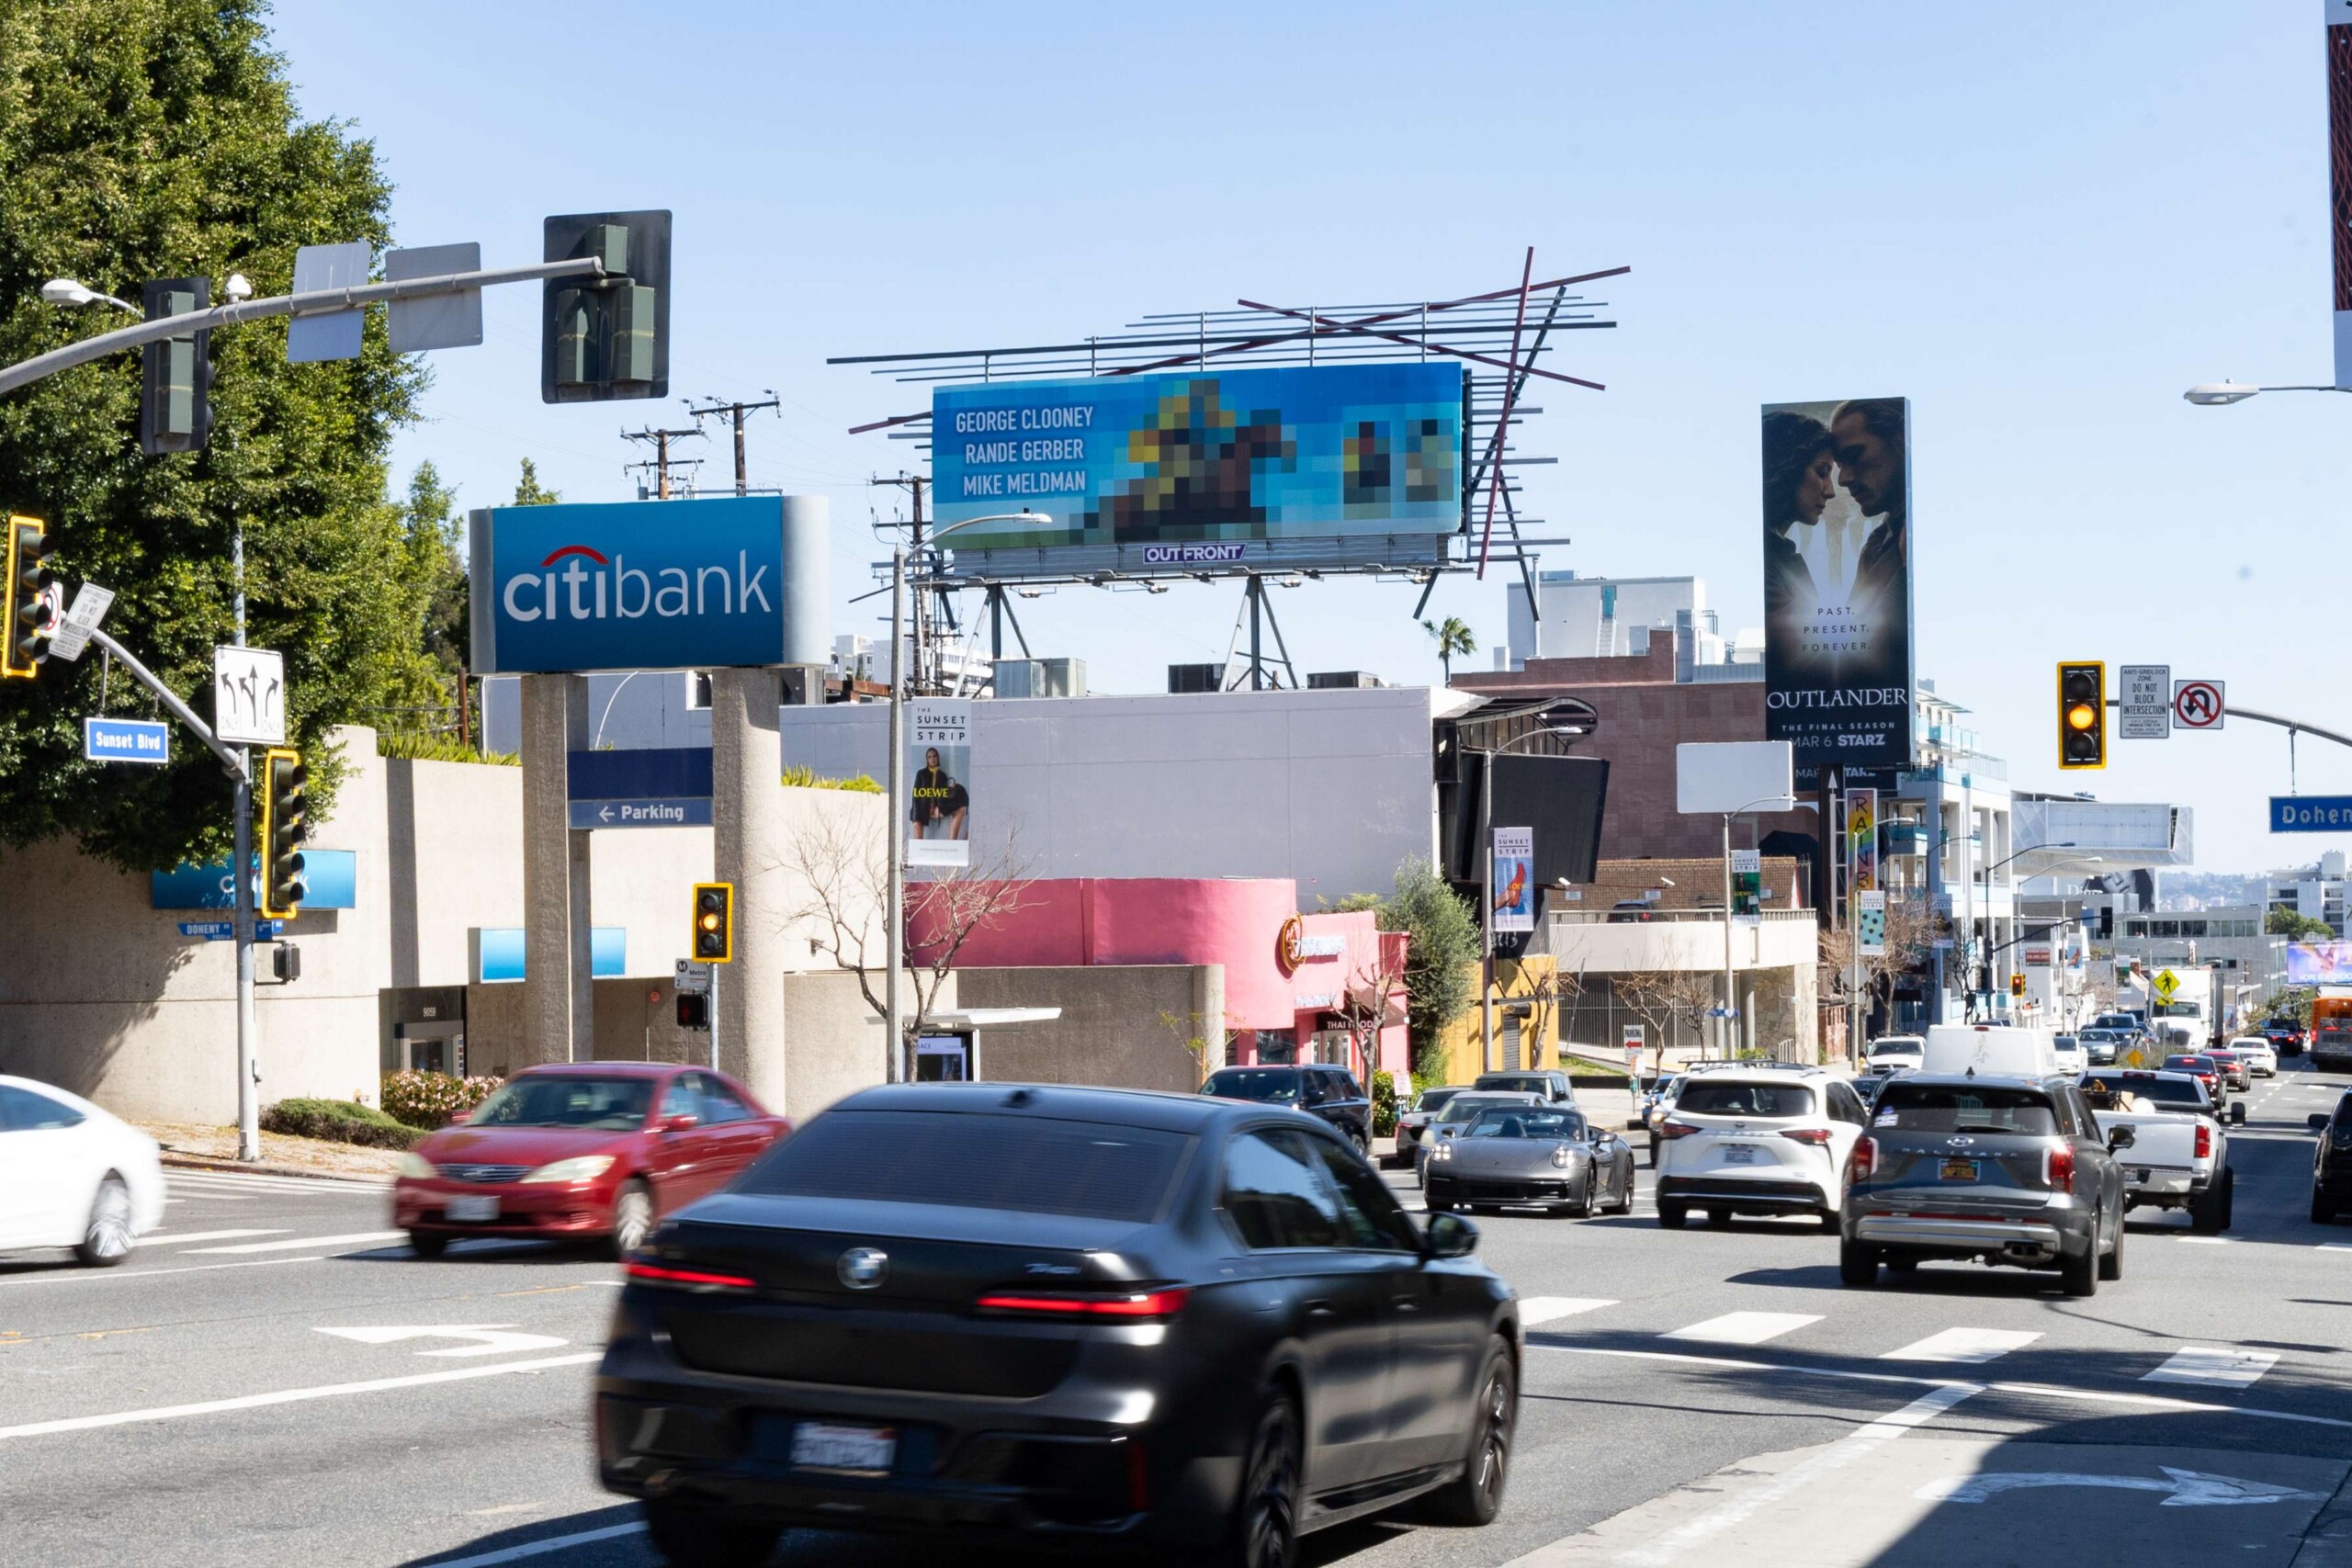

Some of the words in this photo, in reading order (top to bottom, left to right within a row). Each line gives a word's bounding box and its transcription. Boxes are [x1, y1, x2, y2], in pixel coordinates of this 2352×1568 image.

[956, 410, 1017, 433] GEORGE
[1022, 406, 1093, 430] CLOONEY
[966, 442, 1017, 464] RANDE
[1022, 438, 1083, 461] GERBER
[964, 474, 1002, 496] MIKE
[1007, 470, 1086, 494] MELDMAN
[503, 545, 772, 622] citibank
[1817, 606, 1855, 615] PAST.
[1804, 624, 1870, 634] PRESENT.
[1803, 642, 1871, 652] FOREVER.
[2132, 683, 2142, 693] DO
[2145, 682, 2157, 693] NOT
[1767, 687, 1908, 709] OUTLANDER
[2134, 694, 2154, 704] BLOCK
[2123, 705, 2165, 715] INTERSECTION
[917, 716, 966, 724] SUNSET
[1781, 724, 1802, 732] THE
[1849, 721, 1895, 729] SEASON
[96, 731, 132, 749] Sunset
[137, 733, 161, 750] Blvd
[917, 731, 966, 741] STRIP
[1790, 735, 1819, 748] MAR
[1824, 735, 1832, 747] 6
[1838, 734, 1885, 747] STARZ
[913, 787, 948, 798] LOEWE
[621, 805, 684, 822] Parking
[187, 923, 220, 934] DOHENY
[1327, 1021, 1346, 1030] THAI
[1348, 1021, 1374, 1029] FOD
